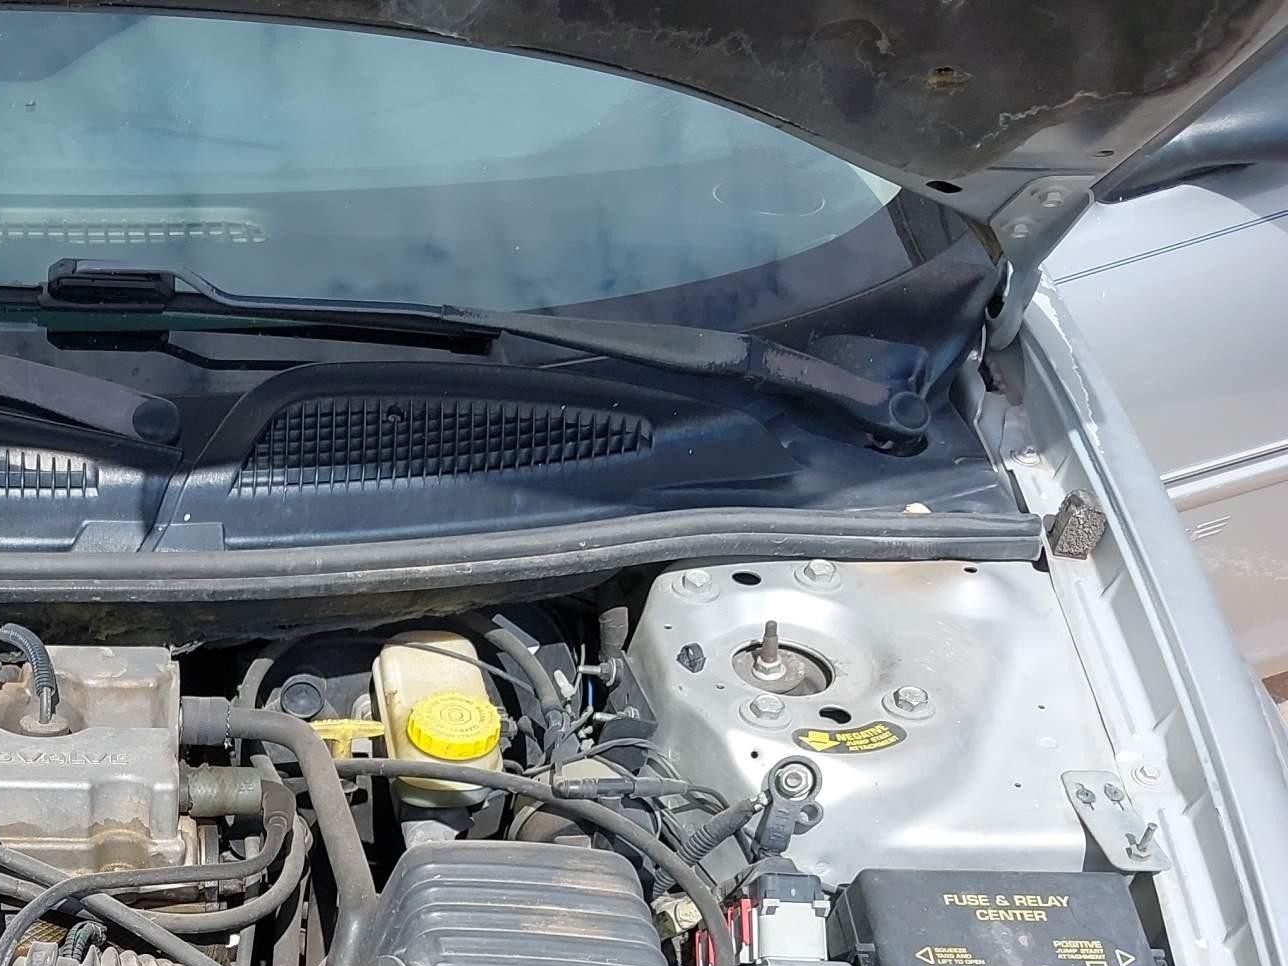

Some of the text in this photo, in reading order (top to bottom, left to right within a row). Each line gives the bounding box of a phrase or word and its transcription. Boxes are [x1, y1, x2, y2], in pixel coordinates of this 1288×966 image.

[835, 724, 889, 742] NEGATIVE
[848, 735, 899, 751] ATTACHMENT
[943, 894, 1069, 907] FUSE & RELAY
[975, 909, 1048, 922] CENTER
